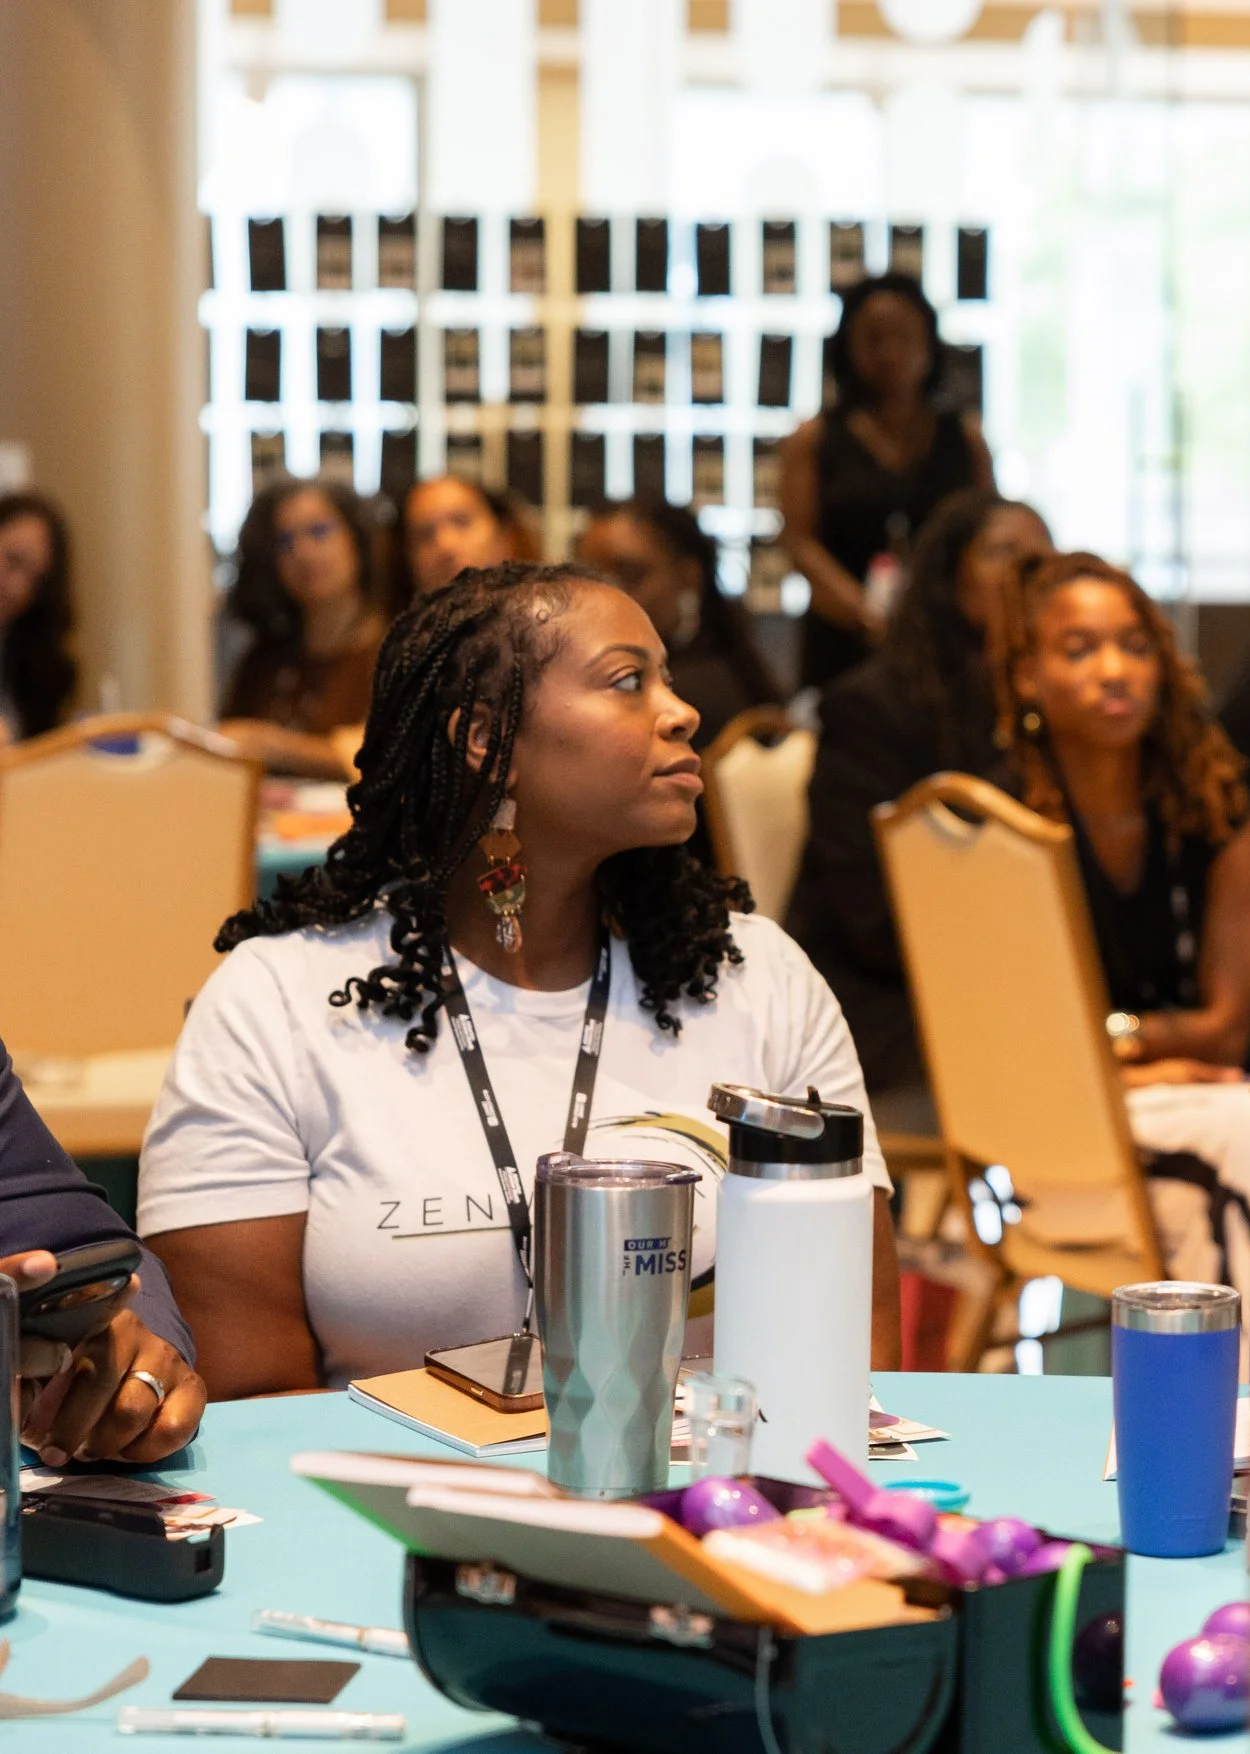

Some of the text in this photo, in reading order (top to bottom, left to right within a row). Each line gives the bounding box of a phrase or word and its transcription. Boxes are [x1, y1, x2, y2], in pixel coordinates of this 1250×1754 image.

[377, 1193, 494, 1230] ZEN
[627, 1239, 654, 1251] OUR
[635, 1248, 687, 1276] MISS
